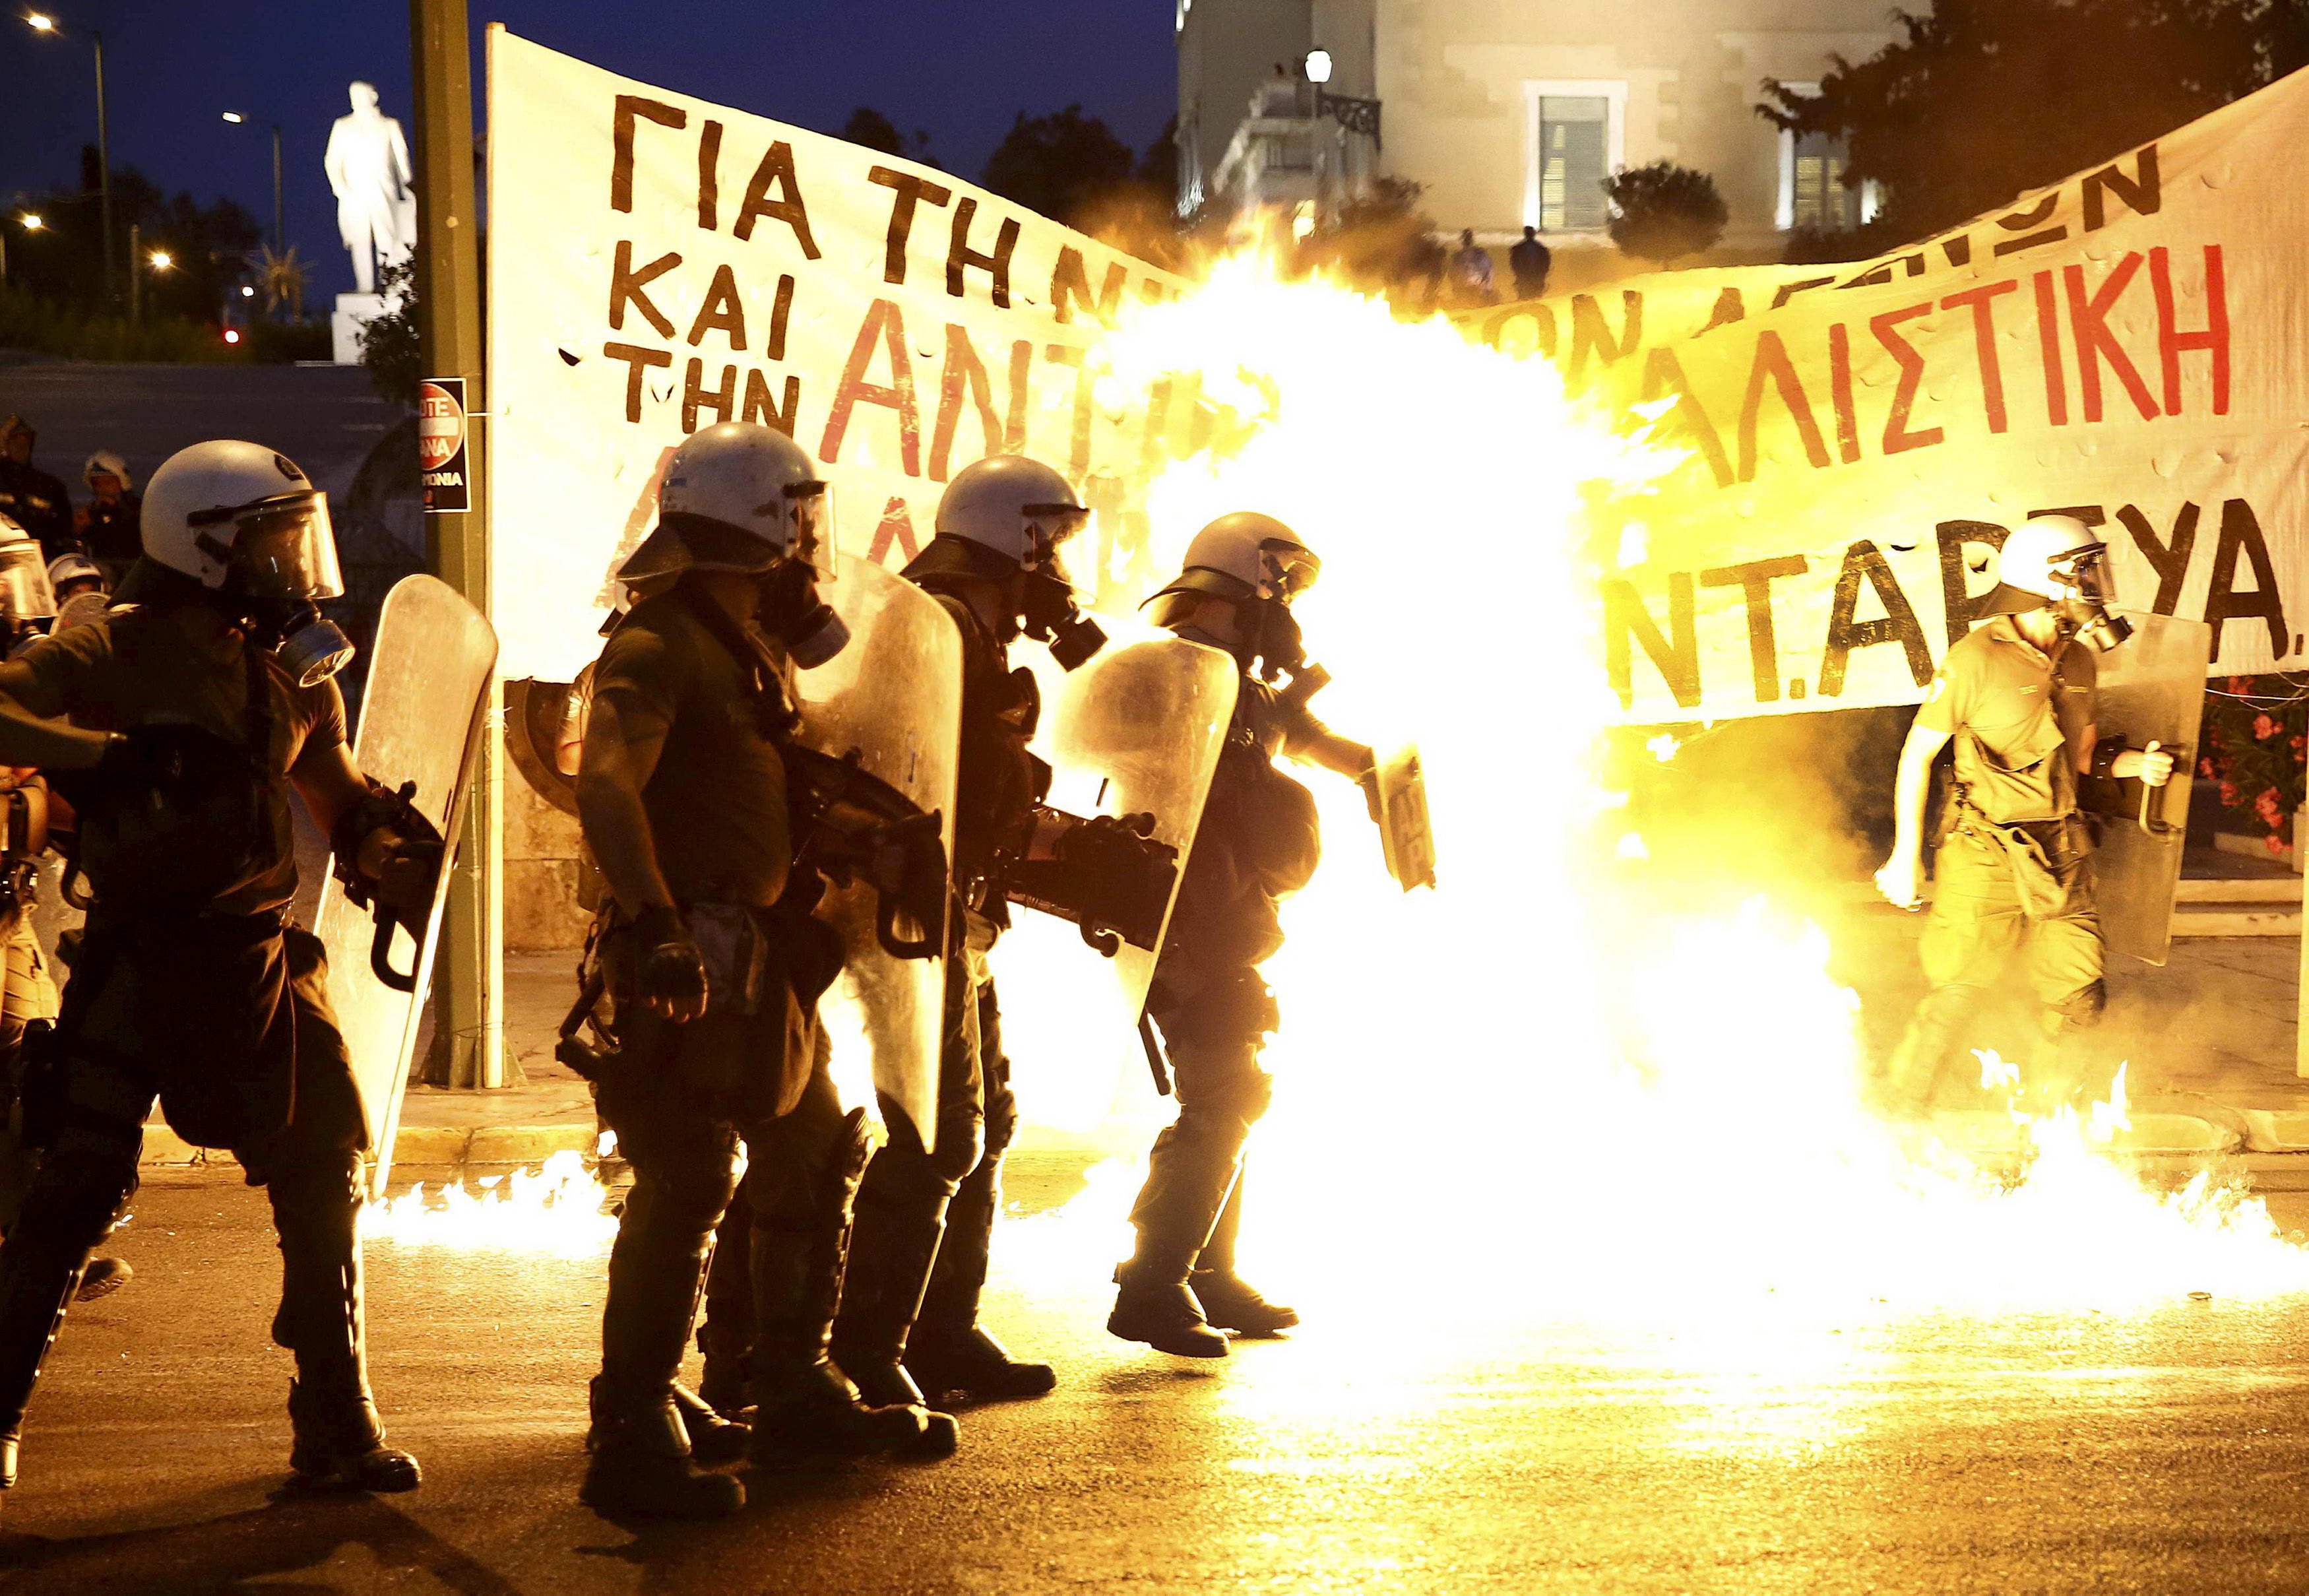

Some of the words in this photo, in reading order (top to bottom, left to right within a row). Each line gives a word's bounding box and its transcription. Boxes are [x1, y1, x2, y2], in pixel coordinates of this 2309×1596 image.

[612, 94, 821, 259] ΓΙΑ
[868, 166, 1020, 309] ΤΗ
[610, 240, 794, 352] ΚΑΙ
[604, 342, 800, 438] ΤΗΝ
